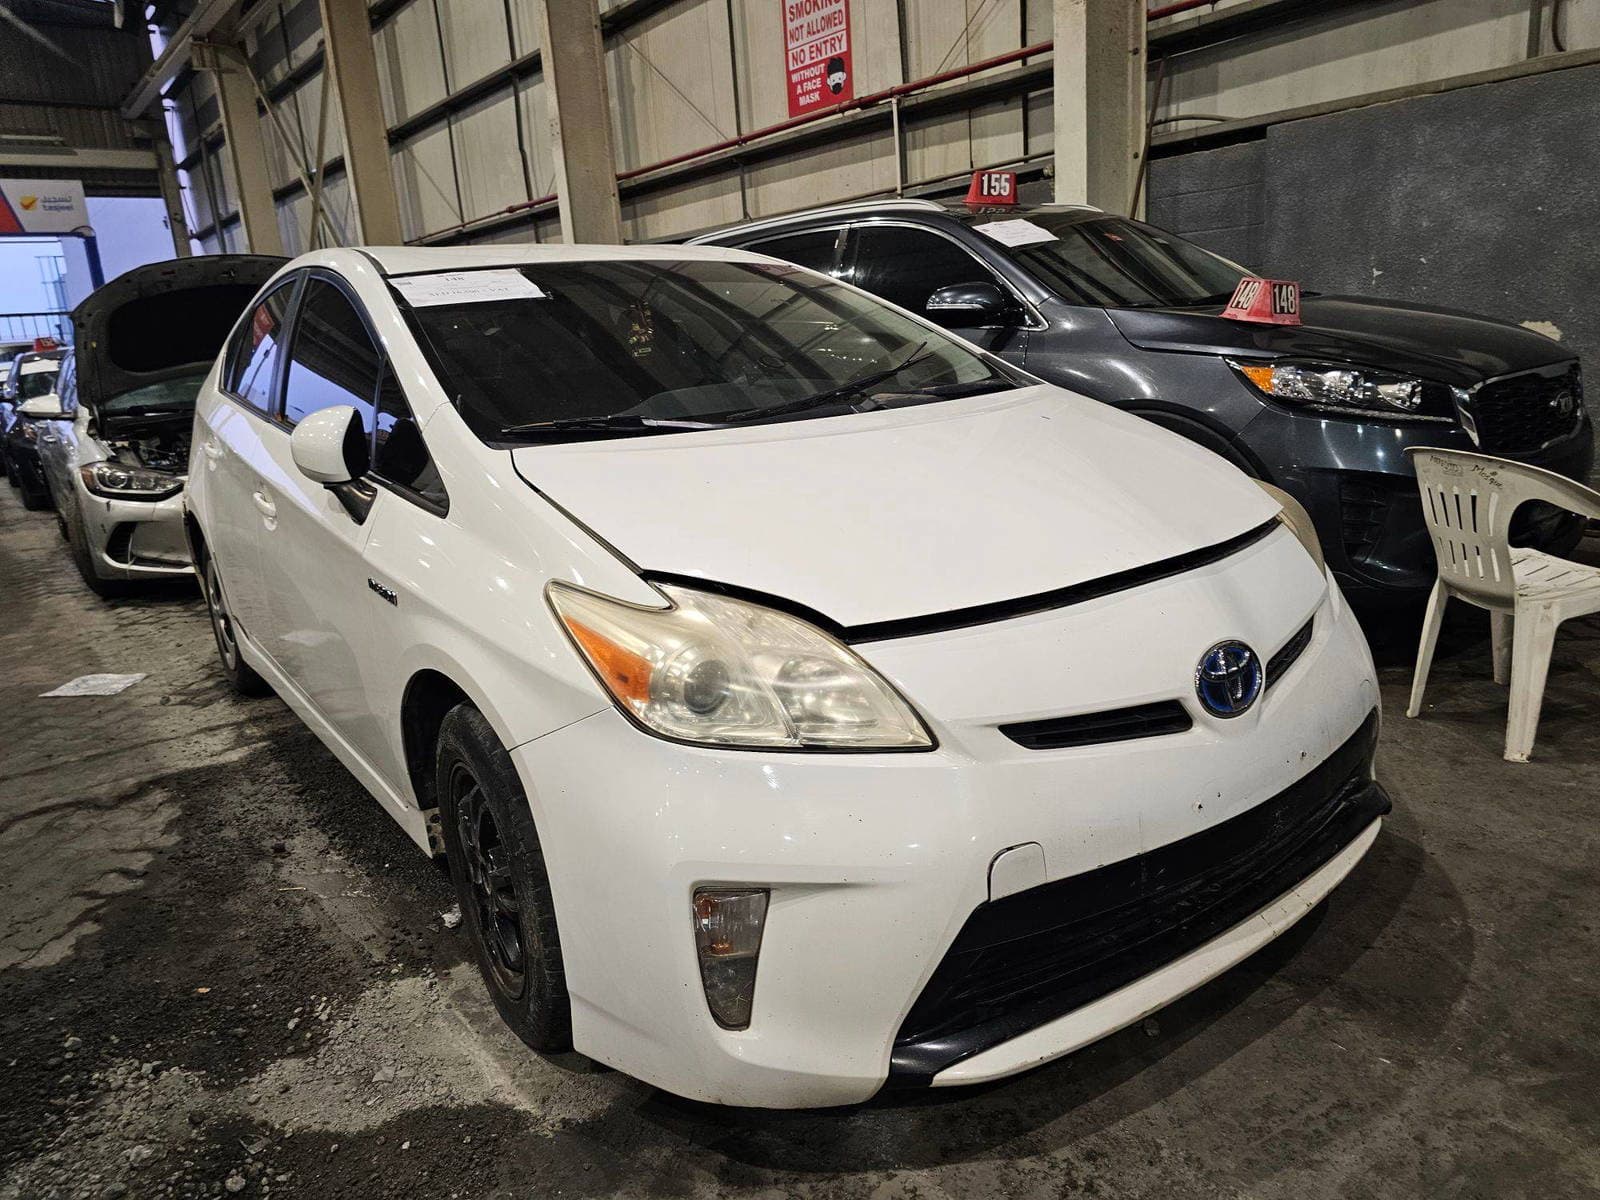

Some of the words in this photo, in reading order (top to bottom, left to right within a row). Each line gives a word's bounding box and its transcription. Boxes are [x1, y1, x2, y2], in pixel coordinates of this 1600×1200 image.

[789, 0, 842, 22] SMOKI
[789, 24, 804, 44] NOT
[807, 9, 844, 38] ALLOWED
[791, 48, 806, 67] NO
[809, 33, 844, 60] ENTRY
[791, 63, 825, 83] WITHOUT
[796, 84, 803, 95] A
[803, 77, 822, 92] FACE
[799, 91, 820, 106] MASK
[982, 173, 1010, 196] 155
[1231, 281, 1260, 309] 148
[1273, 284, 1296, 313] 148
